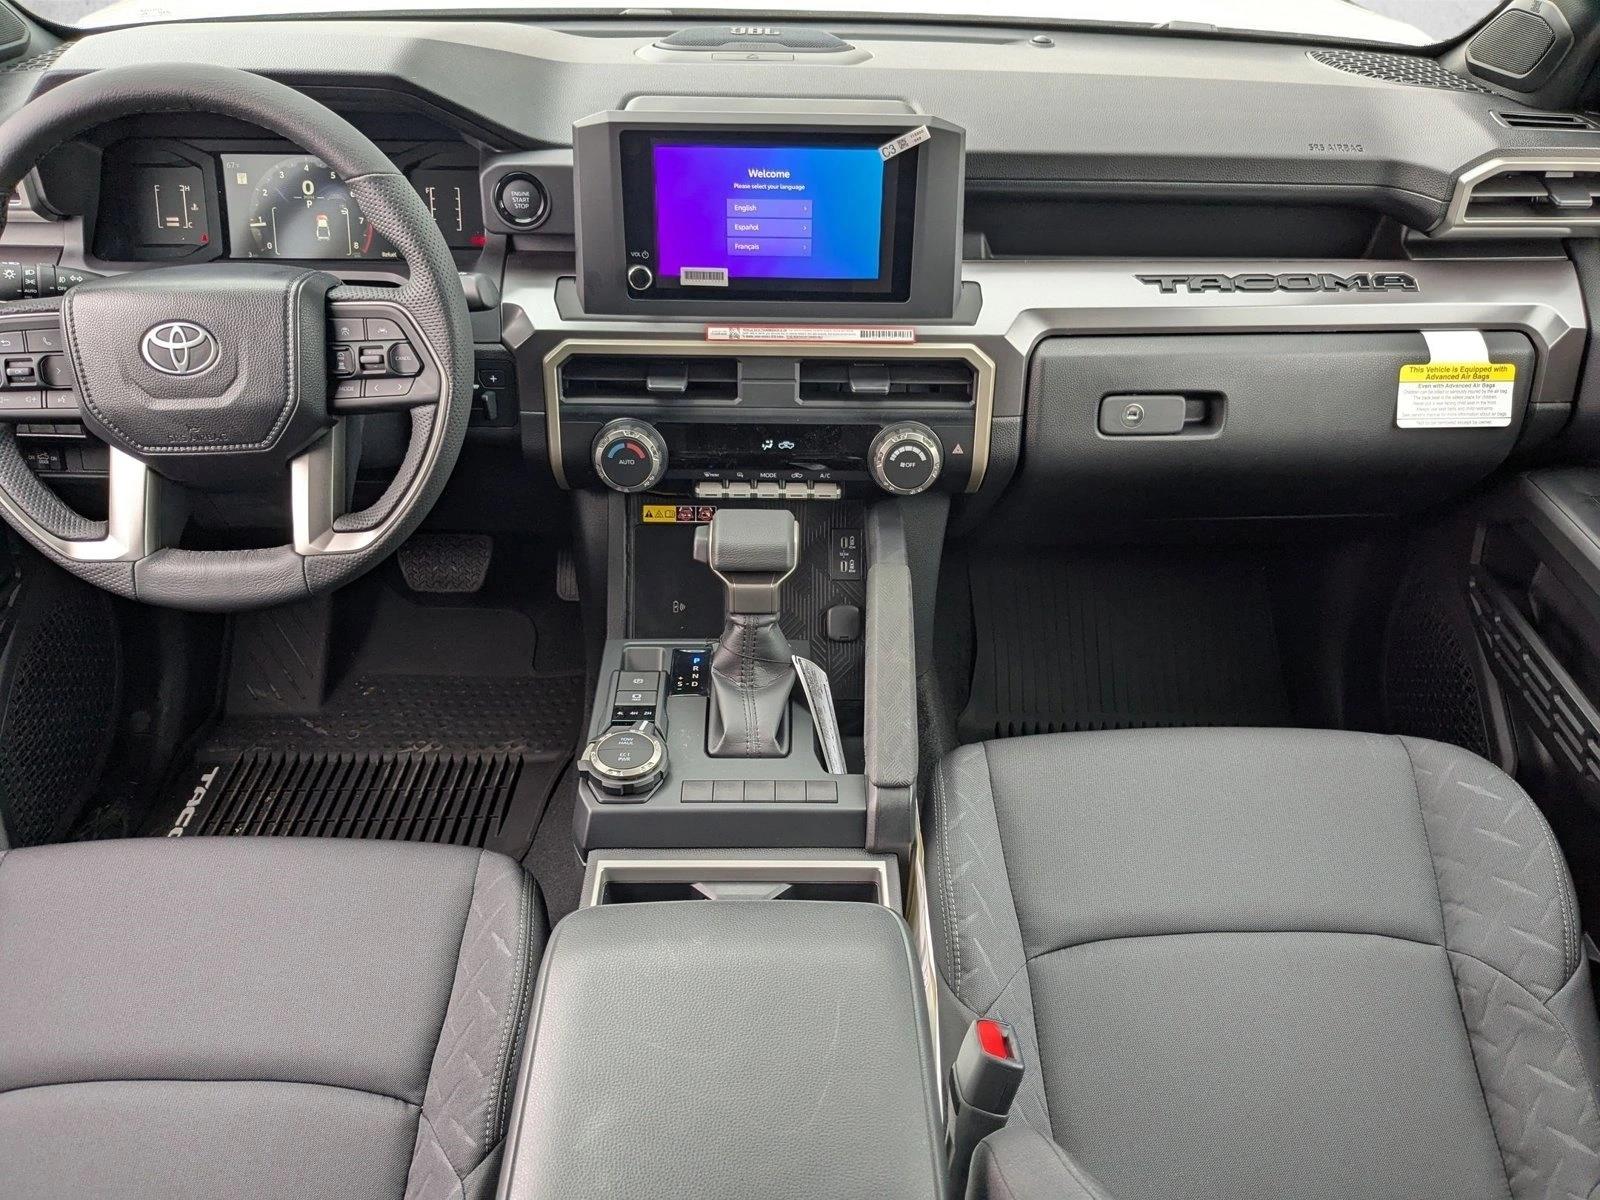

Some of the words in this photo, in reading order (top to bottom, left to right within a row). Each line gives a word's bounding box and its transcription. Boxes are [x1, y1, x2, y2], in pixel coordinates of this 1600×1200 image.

[882, 144, 896, 158] C3
[1308, 143, 1325, 151] SRS
[1328, 143, 1364, 152] AIRBAG
[304, 164, 310, 172] 4
[279, 171, 285, 179] 3
[330, 171, 336, 179] 5
[748, 168, 791, 179] Welcome
[302, 180, 315, 195] 0
[306, 200, 313, 208] P
[734, 204, 757, 212] English
[734, 243, 760, 251] Français
[1132, 273, 1420, 294] TACOMA
[1460, 366, 1492, 374] Equipped
[1472, 373, 1490, 381] Bags
